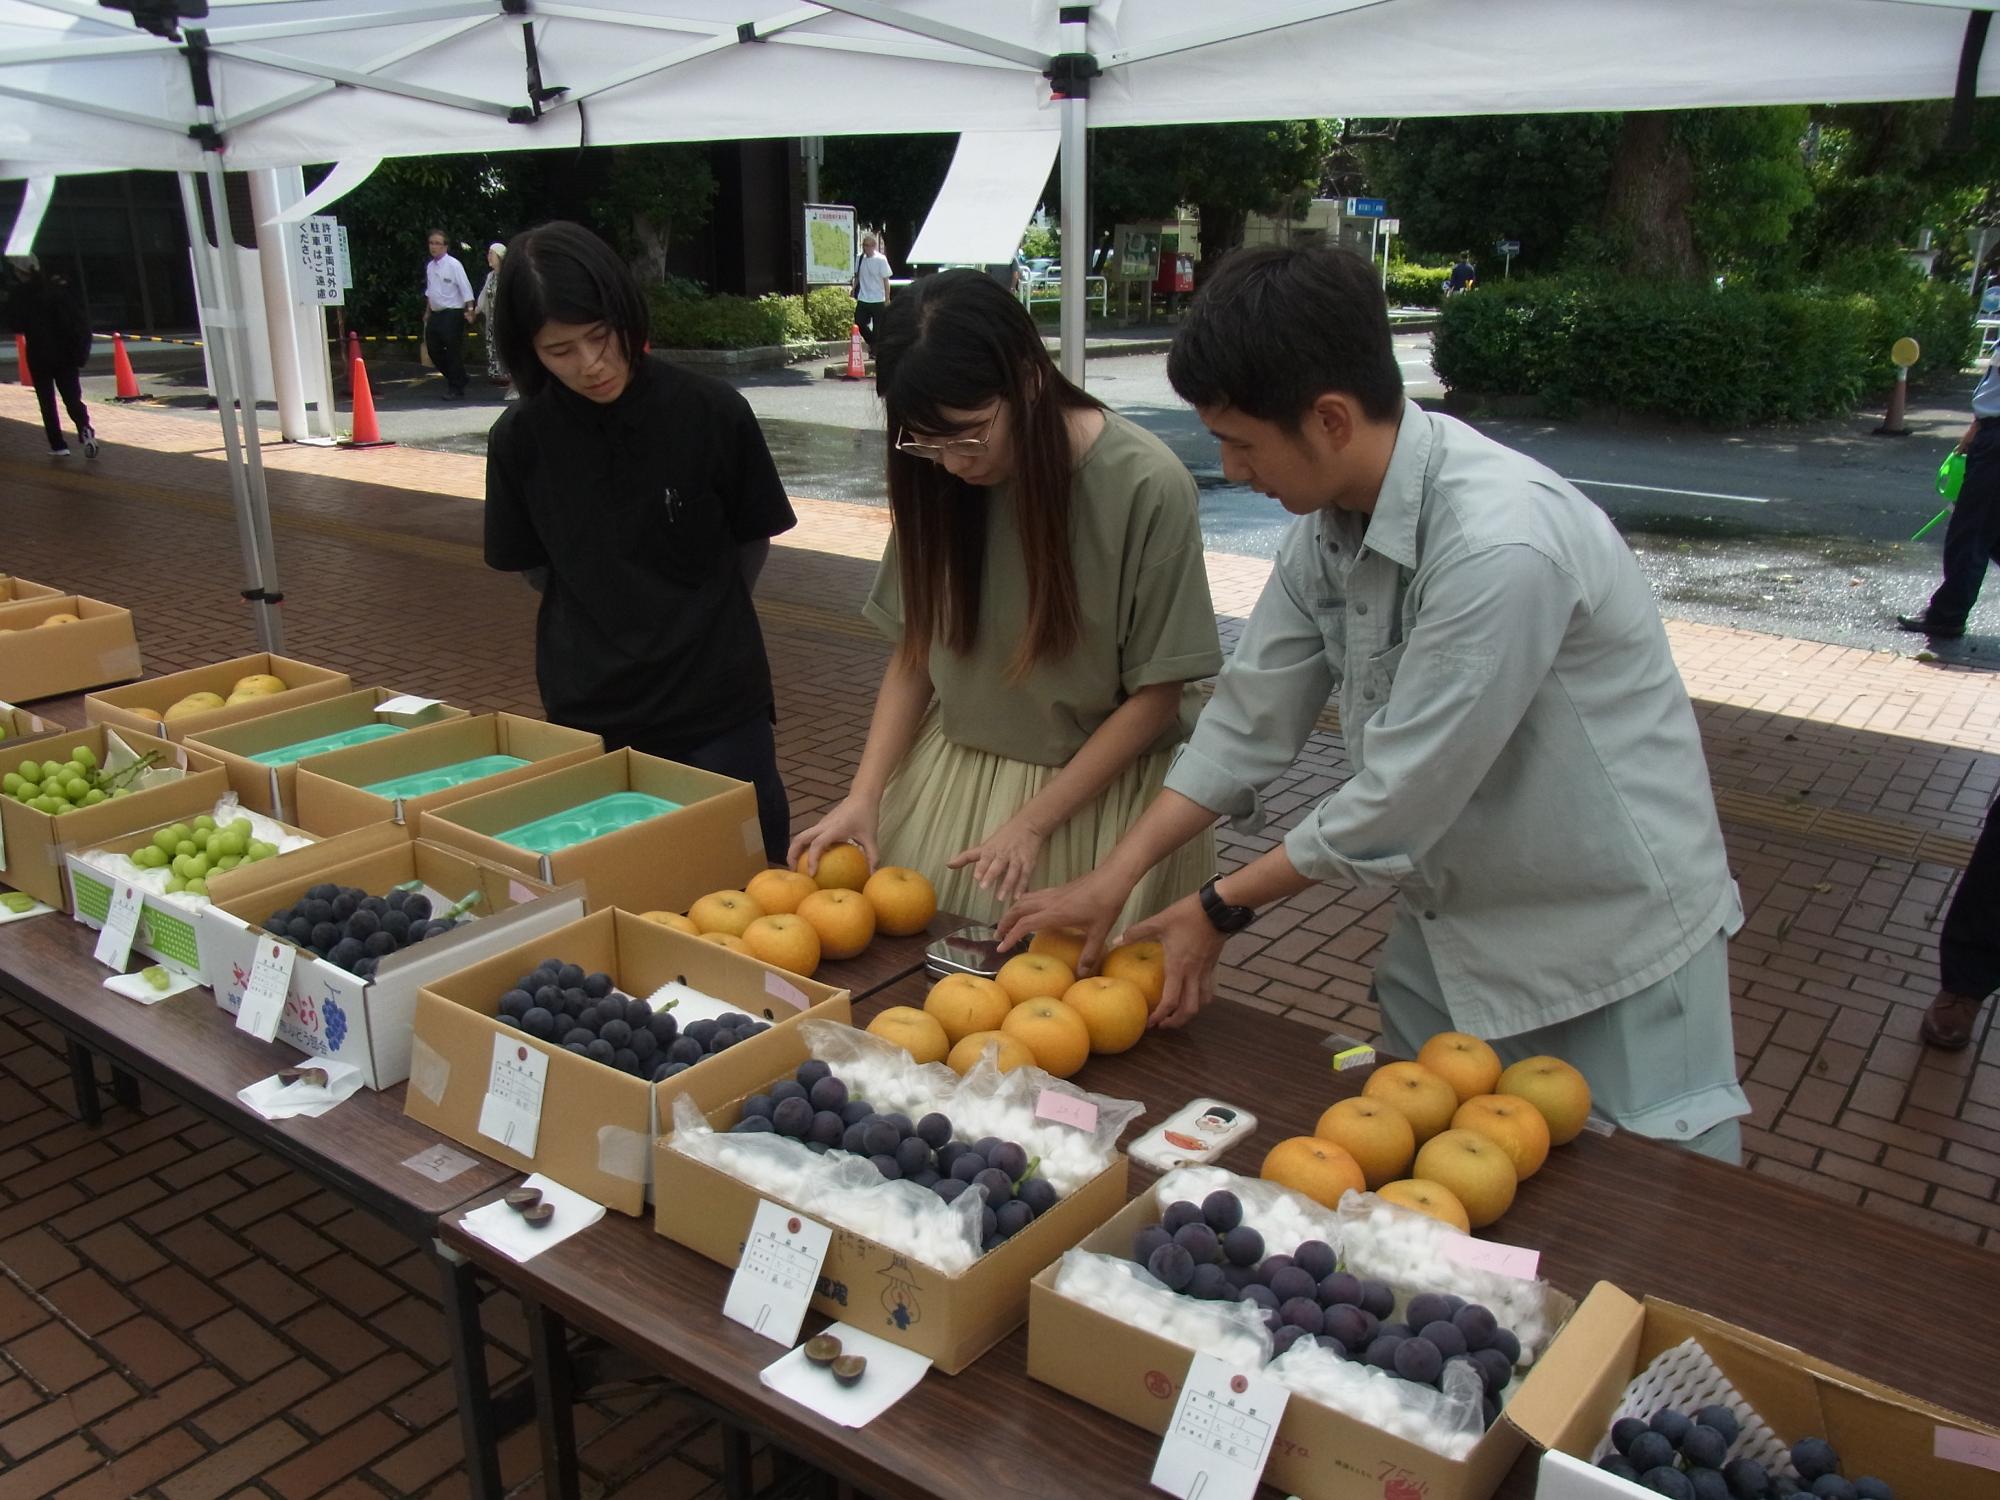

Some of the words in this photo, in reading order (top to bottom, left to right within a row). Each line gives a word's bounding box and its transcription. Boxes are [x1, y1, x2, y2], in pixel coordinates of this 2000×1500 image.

[310, 223, 326, 299] 駐車はご遠慮
[322, 223, 338, 298] 許可車両以外の
